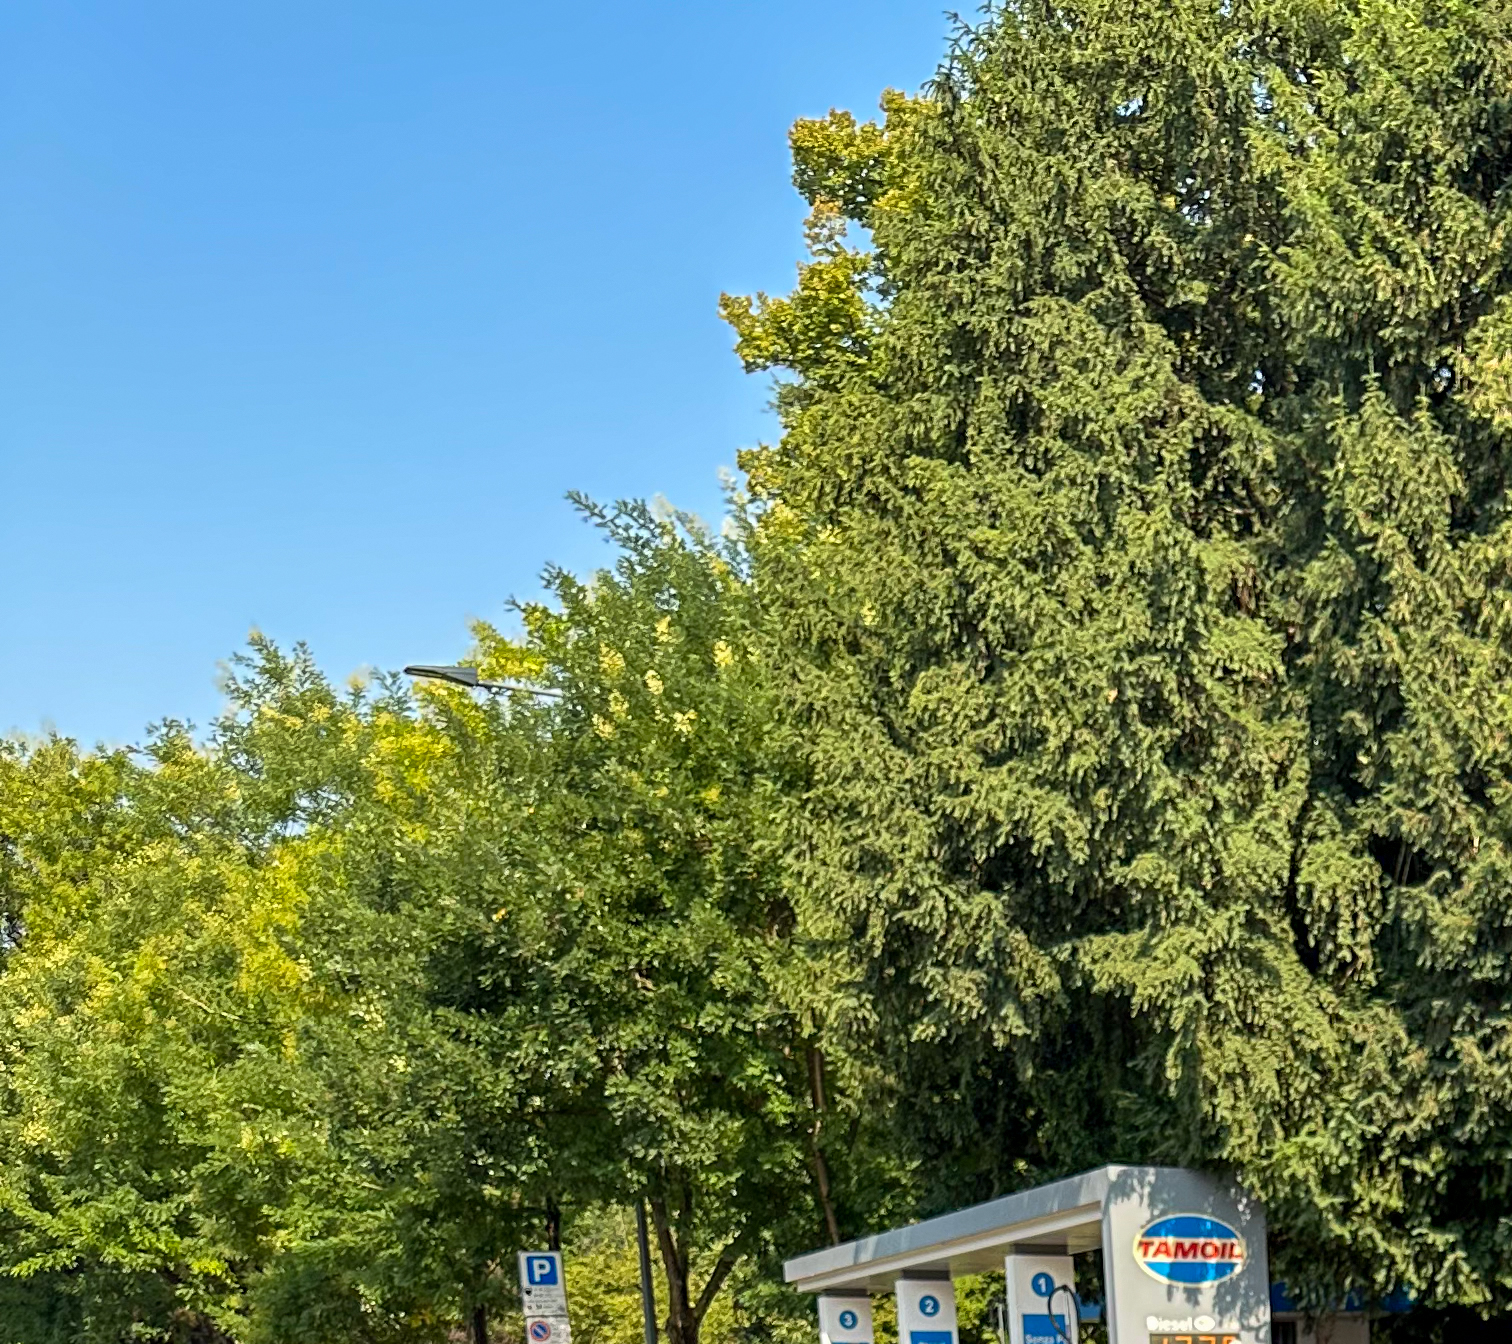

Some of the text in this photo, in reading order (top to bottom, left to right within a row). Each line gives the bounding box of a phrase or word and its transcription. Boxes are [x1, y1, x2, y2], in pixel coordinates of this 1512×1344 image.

[1138, 1240, 1244, 1259] TAMOIL
[533, 1259, 551, 1282] P
[1037, 1277, 1047, 1293] 1
[924, 1299, 935, 1313] 2
[844, 1314, 853, 1327] 3
[1146, 1315, 1193, 1331] Diesel
